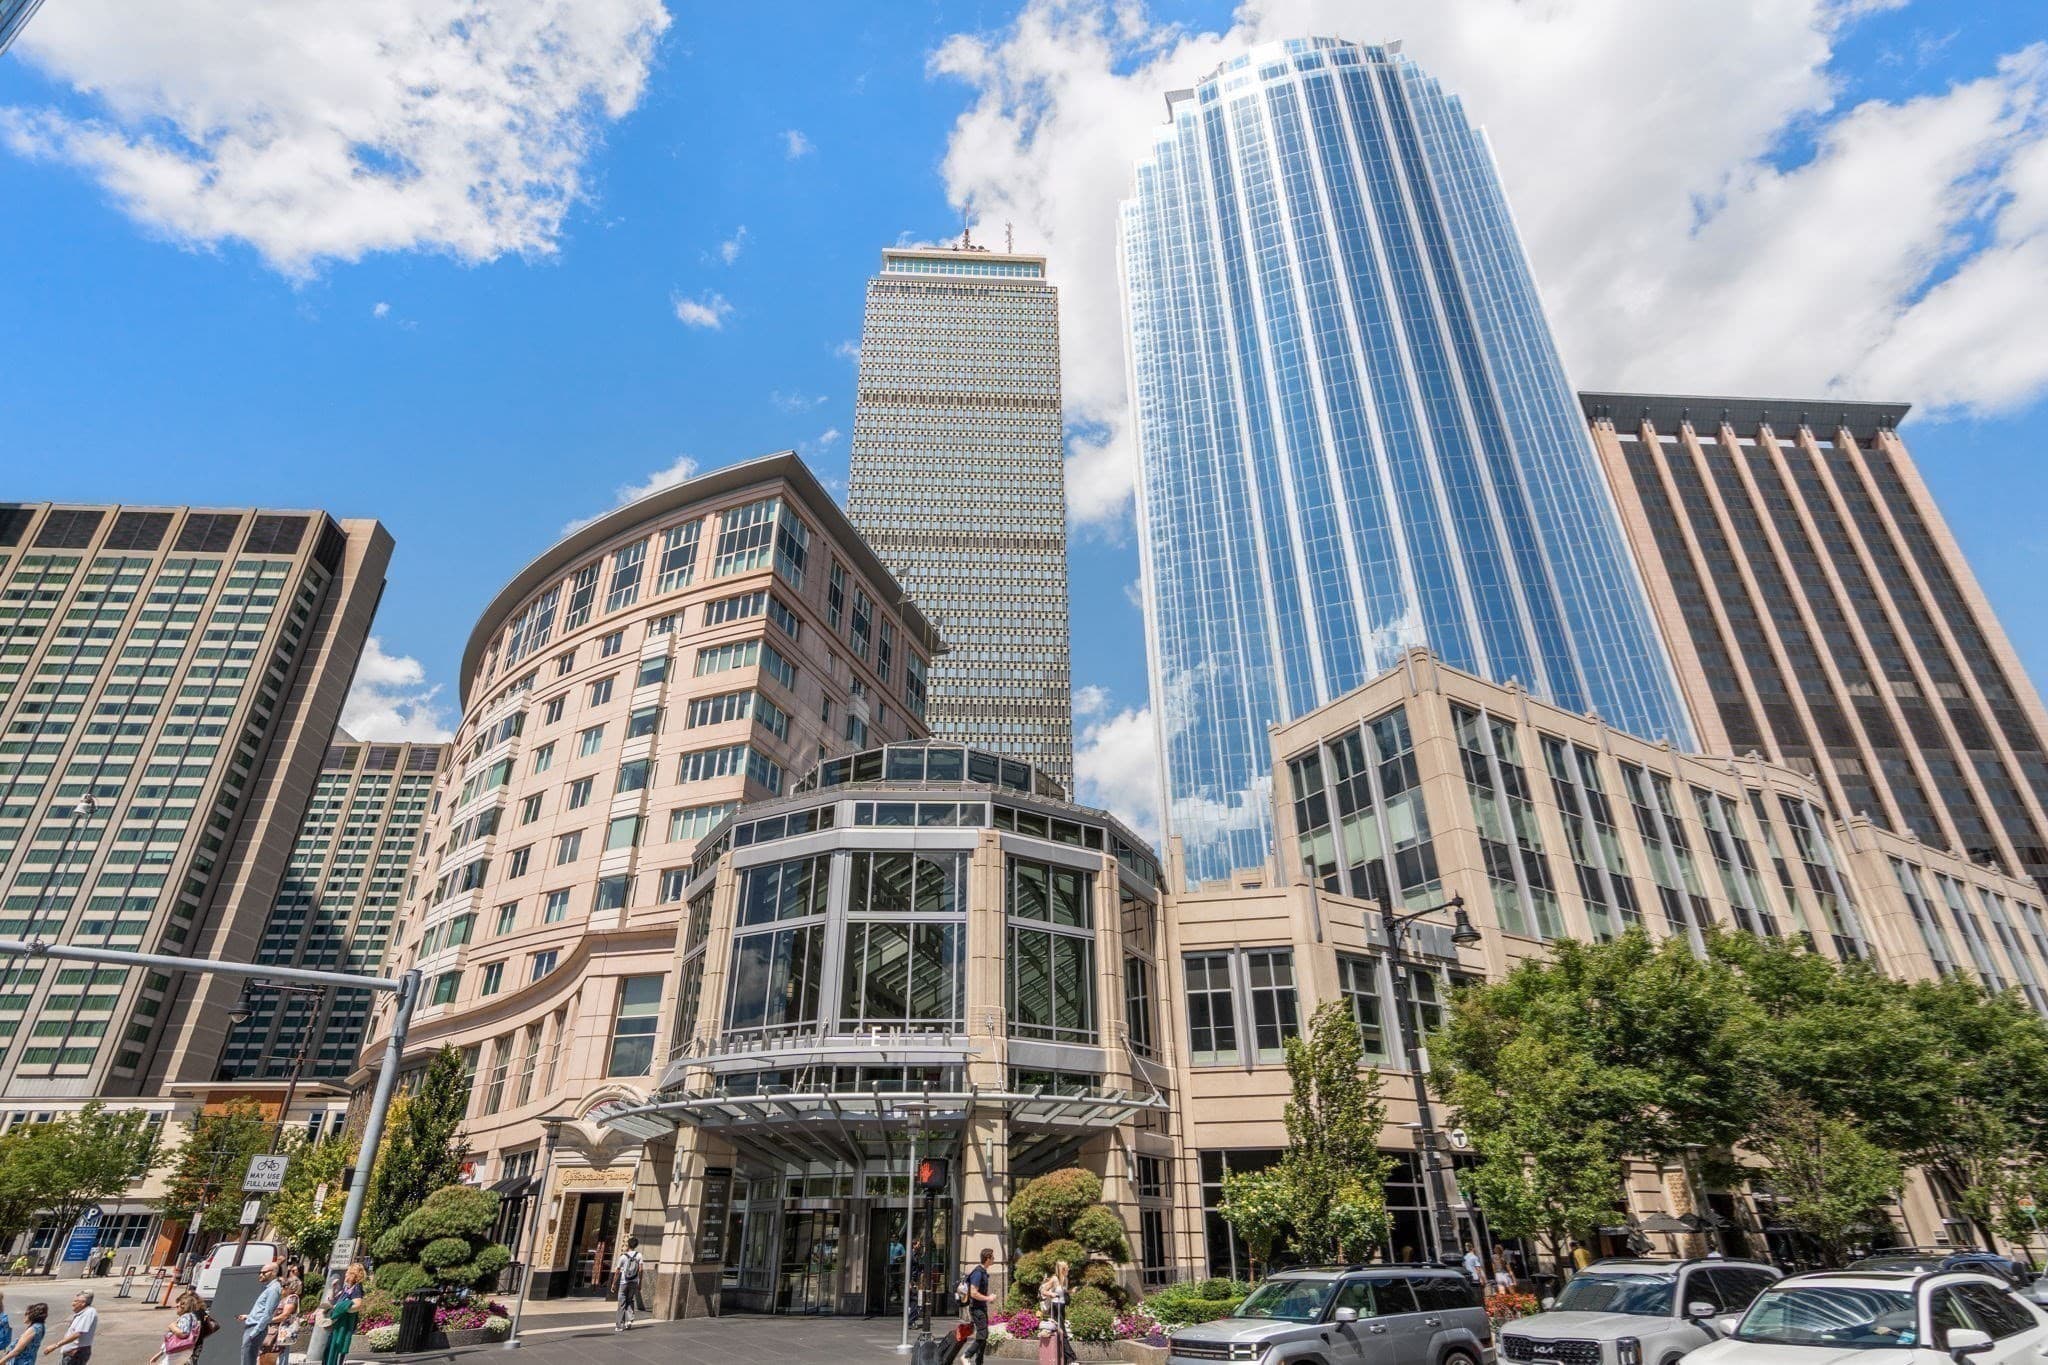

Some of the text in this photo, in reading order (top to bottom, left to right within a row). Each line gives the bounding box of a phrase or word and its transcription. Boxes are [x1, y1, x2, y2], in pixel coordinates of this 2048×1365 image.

[853, 1025, 953, 1047] CENTER
[1453, 1133, 1465, 1146] T
[87, 1208, 99, 1219] P
